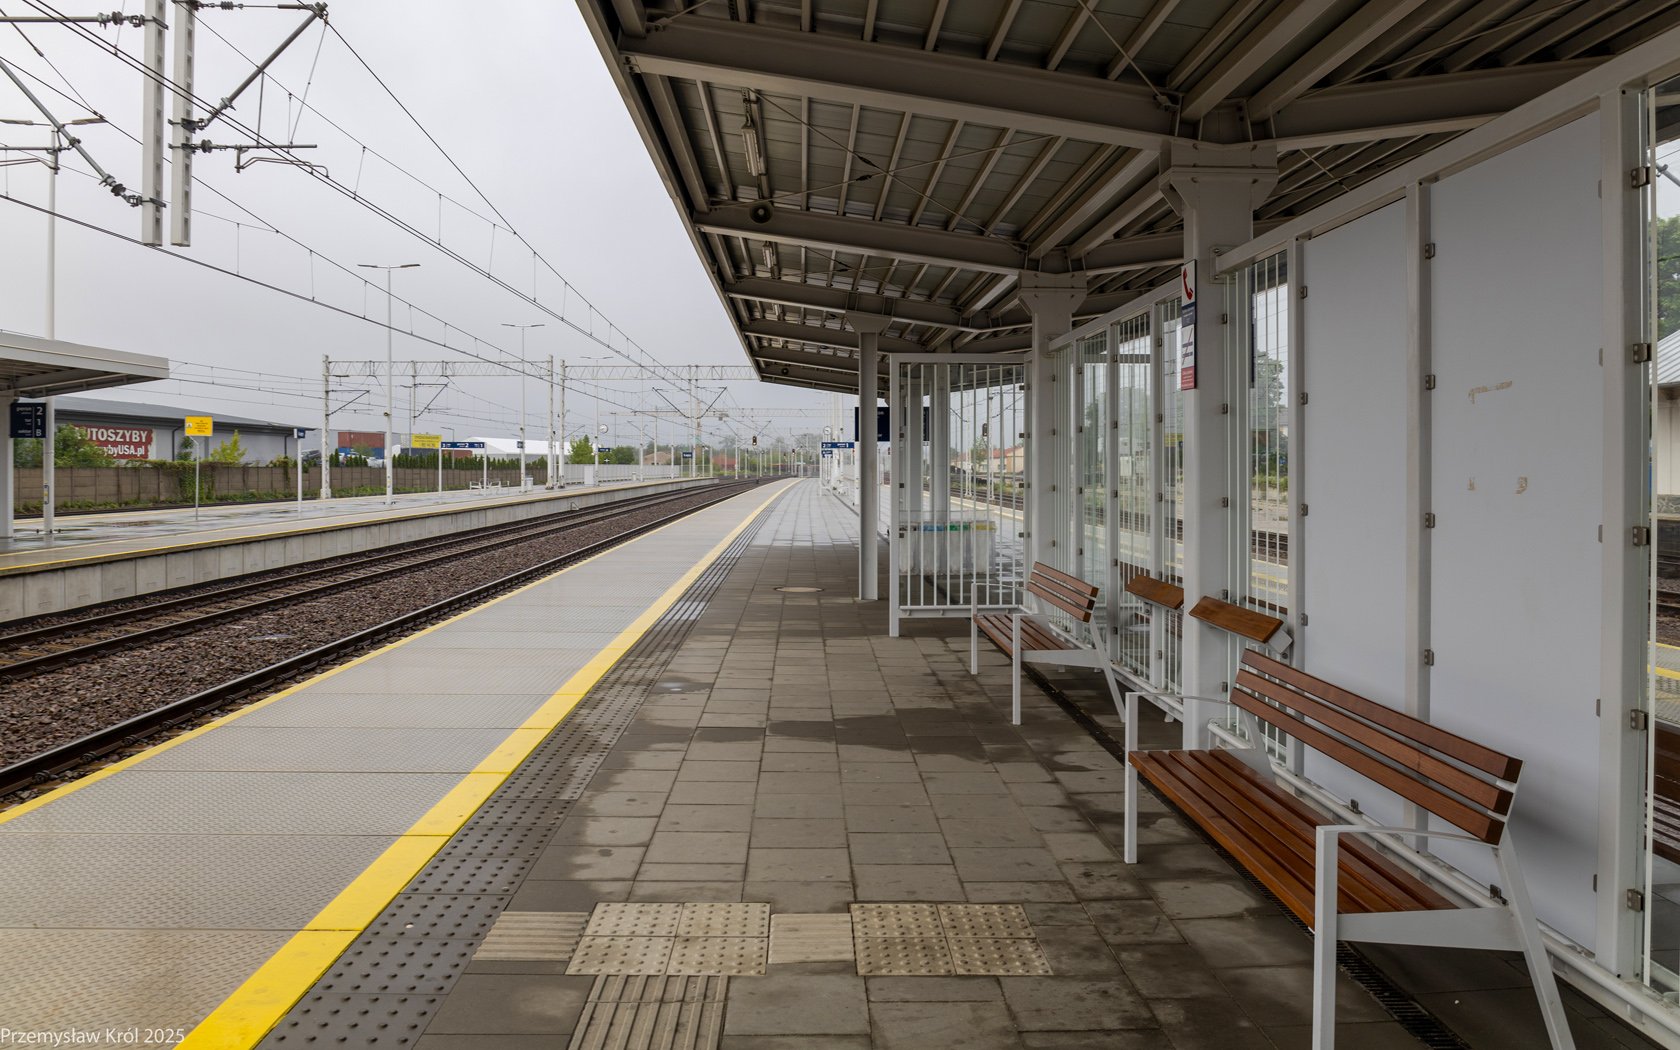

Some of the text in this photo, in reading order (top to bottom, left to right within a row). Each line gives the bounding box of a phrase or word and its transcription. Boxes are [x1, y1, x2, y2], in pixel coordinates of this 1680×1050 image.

[36, 406, 44, 416] 2
[36, 418, 41, 426] 1
[85, 428, 148, 443] UTOSZYBY
[102, 444, 145, 457] ybyUSA.pl
